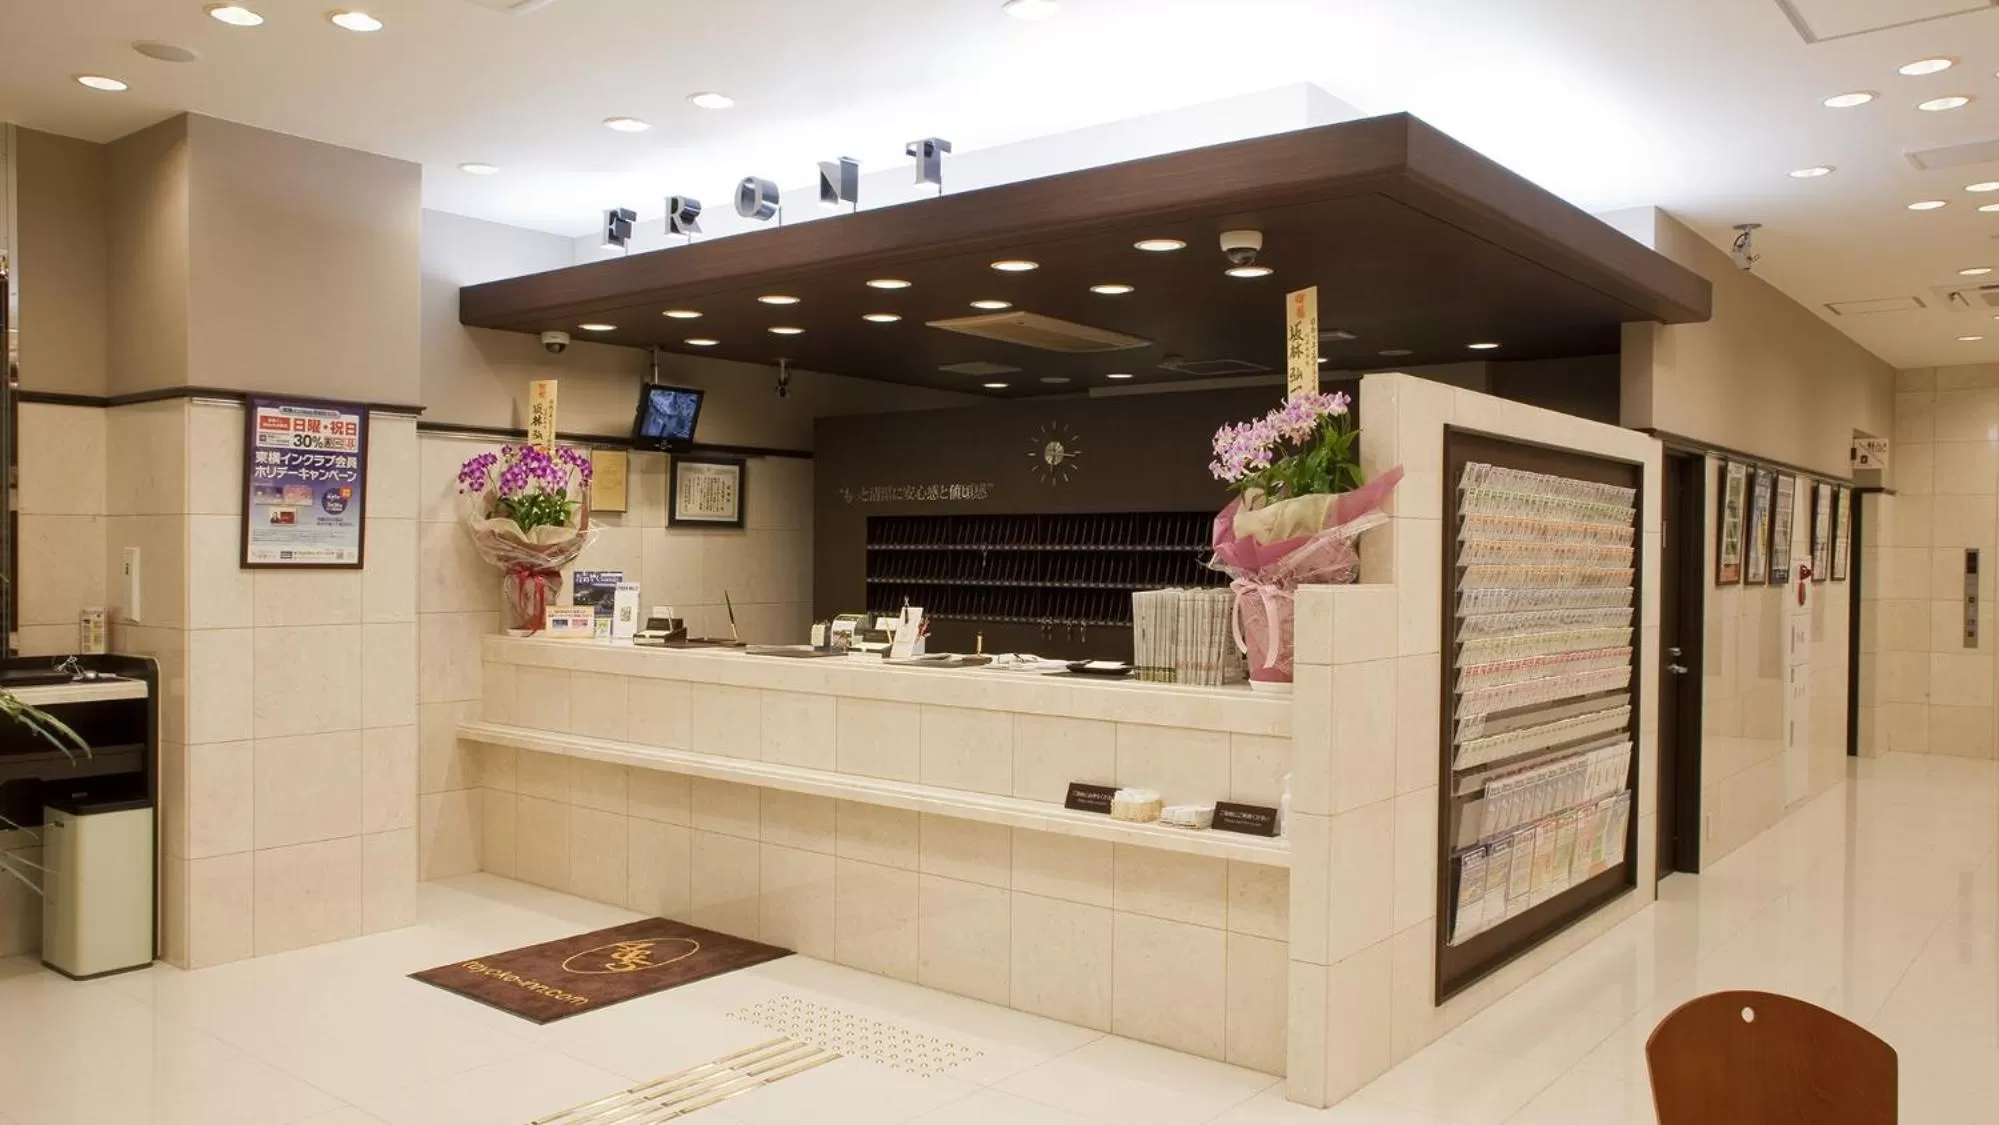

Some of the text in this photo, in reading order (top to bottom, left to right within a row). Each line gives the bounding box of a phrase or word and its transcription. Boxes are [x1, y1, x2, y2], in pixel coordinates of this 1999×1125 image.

[601, 136, 952, 250] FRONT
[255, 451, 358, 469] 東横インクラブ会員
[255, 465, 358, 482] ホリデーキャンペーン
